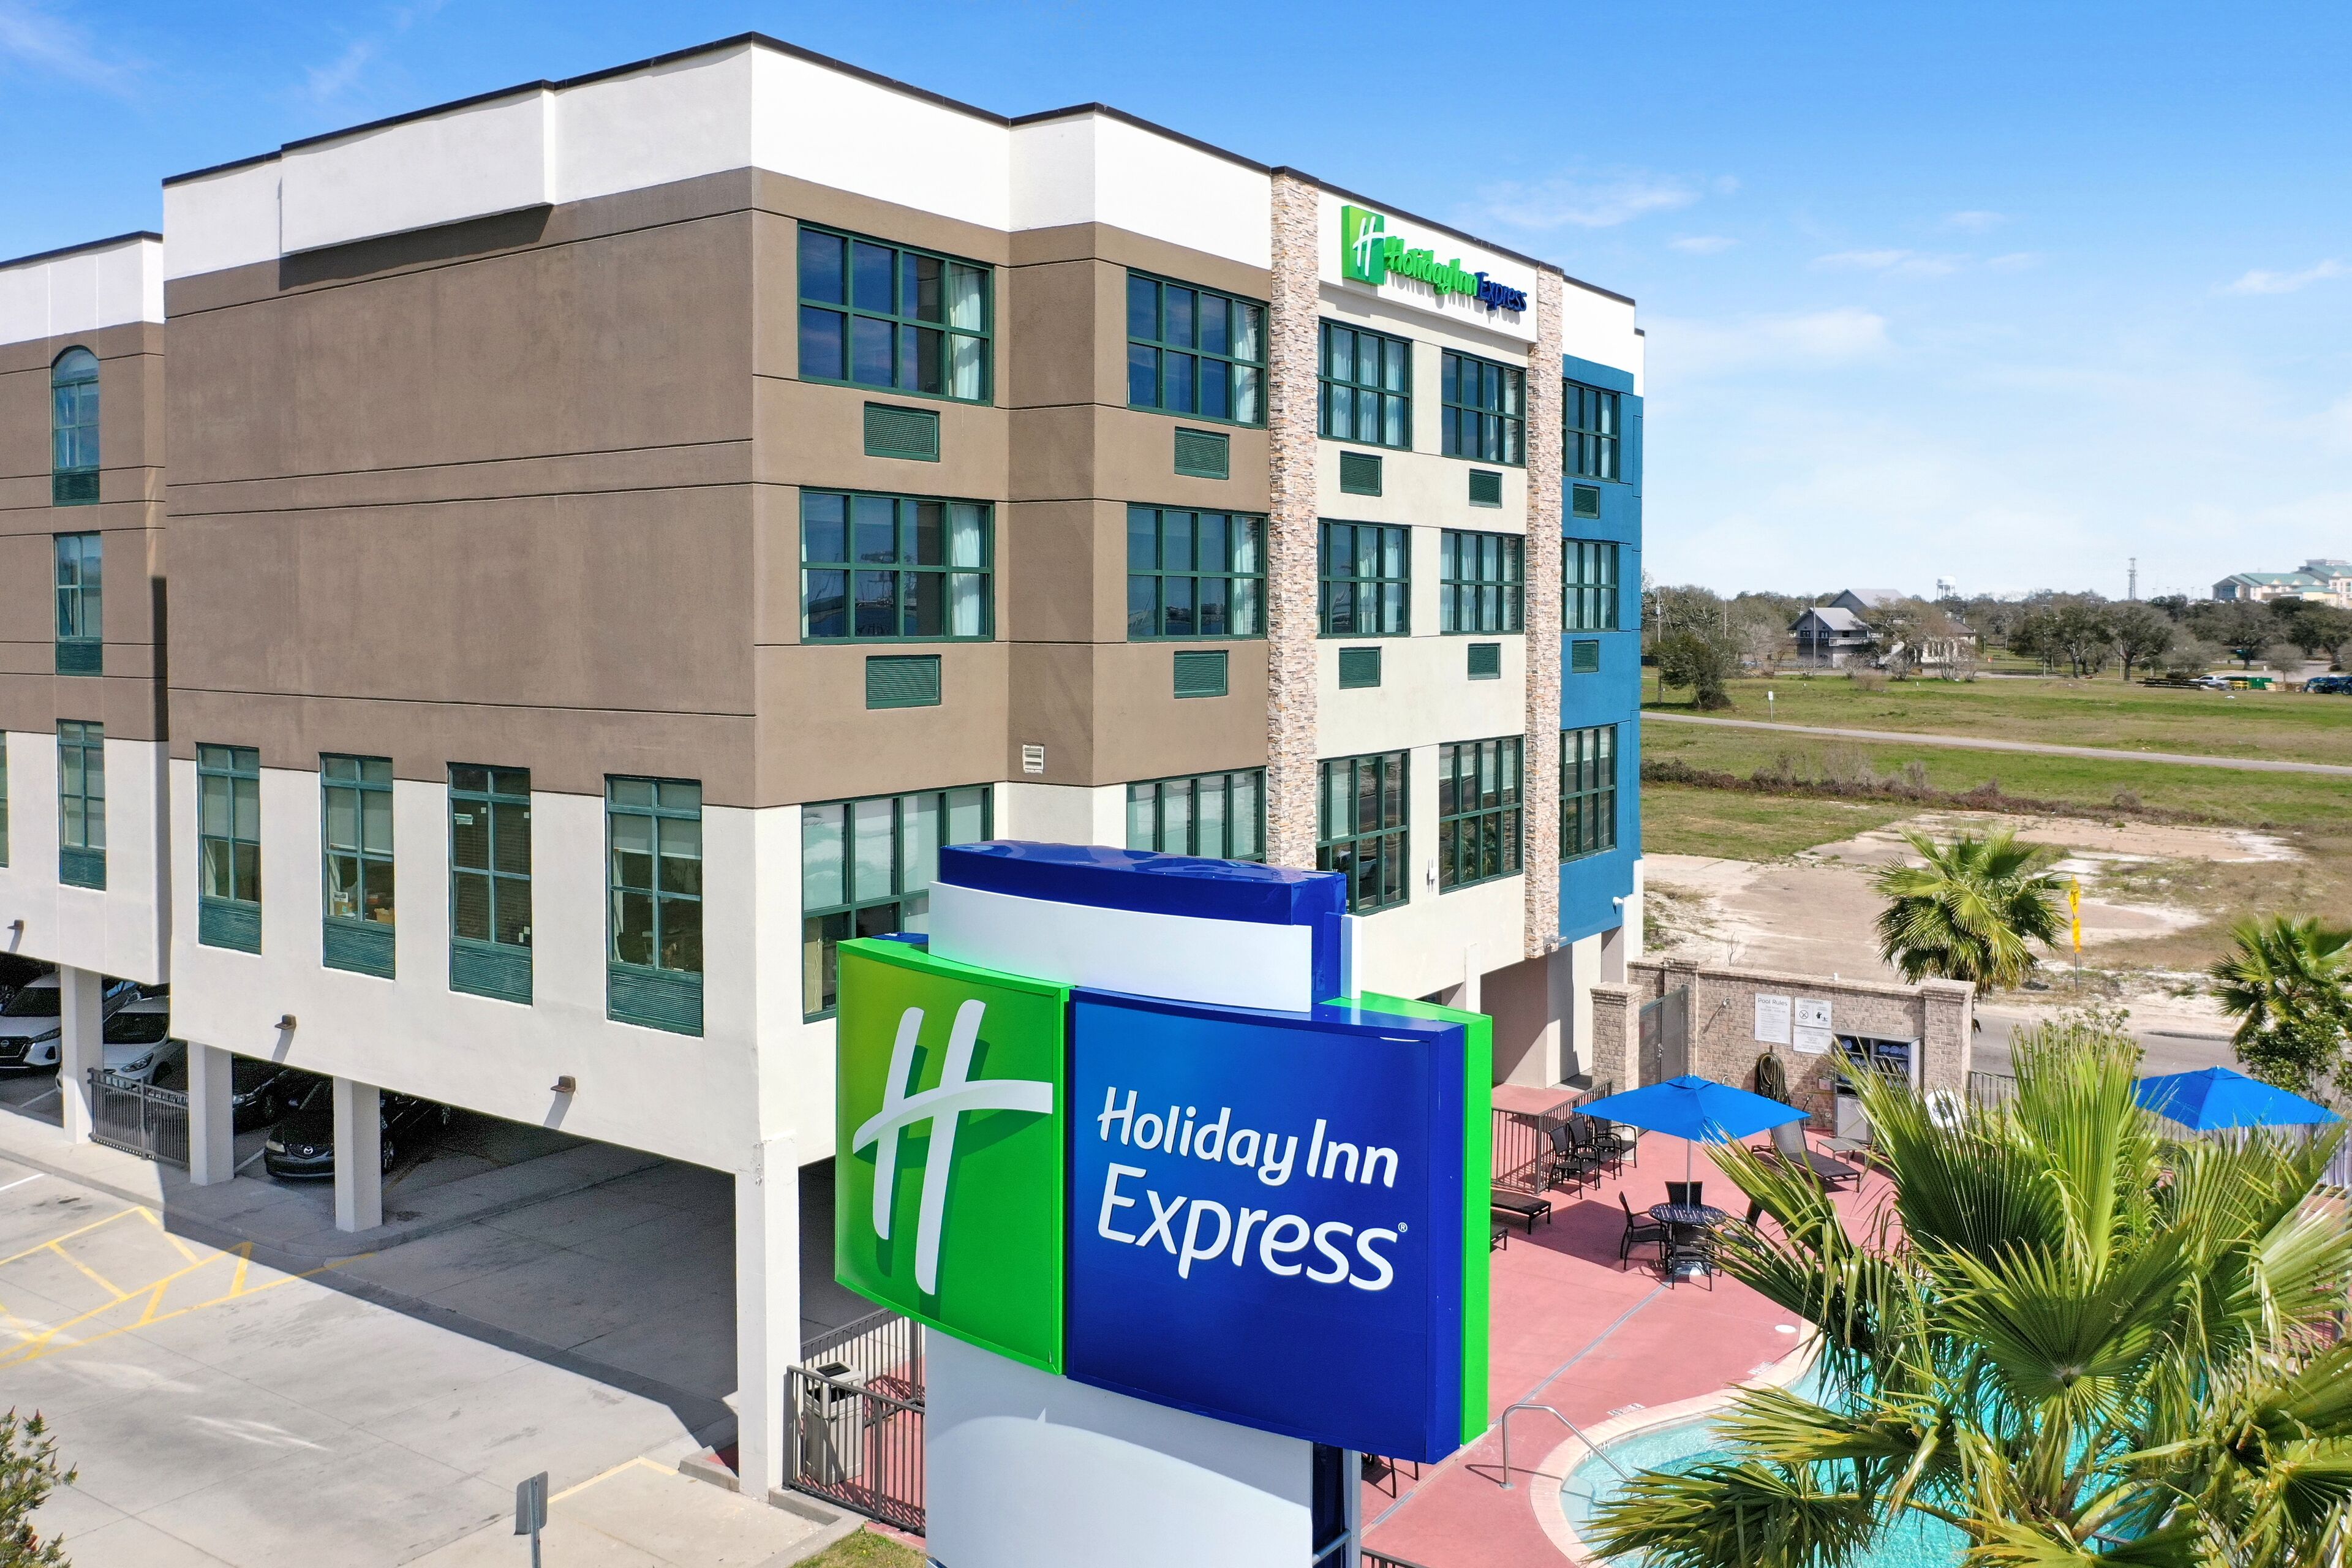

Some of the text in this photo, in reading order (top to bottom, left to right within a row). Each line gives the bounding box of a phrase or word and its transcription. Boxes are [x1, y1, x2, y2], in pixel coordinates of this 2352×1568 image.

[1384, 236, 1527, 312] Holiday Inn Express
[1097, 1087, 1399, 1188] Holiday Inn
